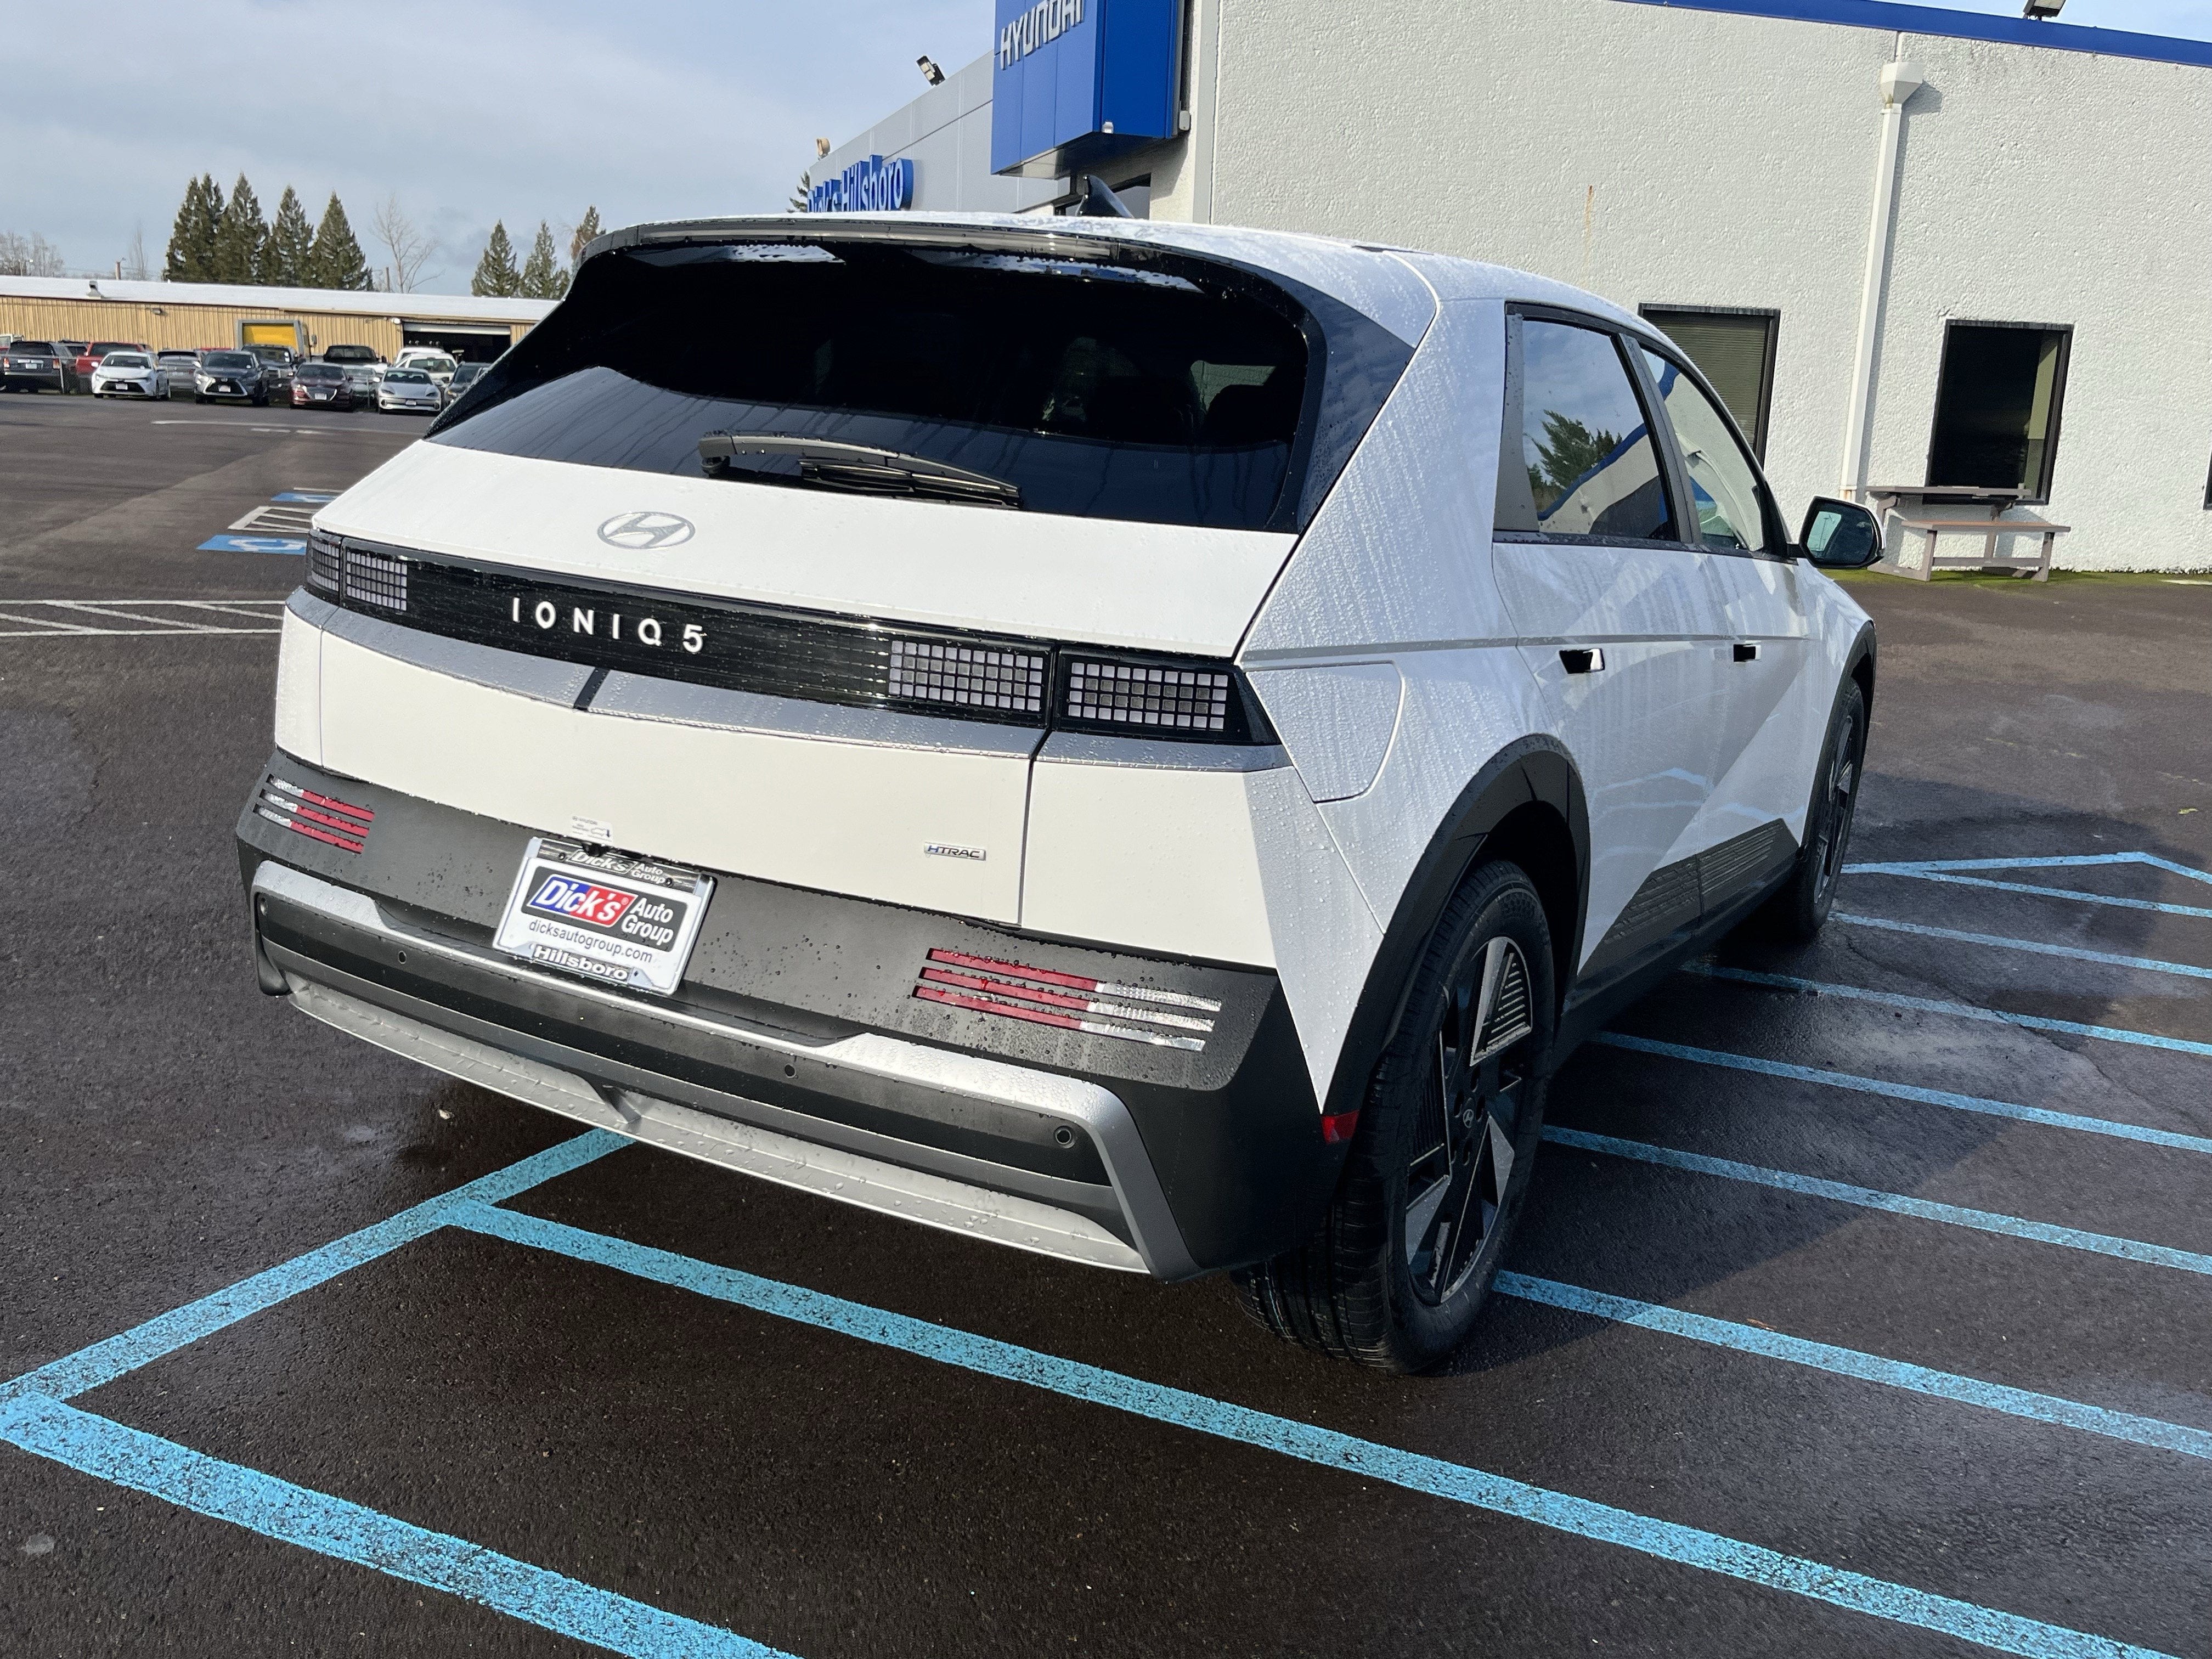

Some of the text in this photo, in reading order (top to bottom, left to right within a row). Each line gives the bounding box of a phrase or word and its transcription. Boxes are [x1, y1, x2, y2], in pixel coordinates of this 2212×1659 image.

[1000, 0, 1084, 70] HYUNDAI
[842, 154, 912, 212] Hillsboro
[512, 597, 703, 653] IONIQ 5
[572, 851, 628, 872] Dick's
[927, 845, 980, 858] HTRAC
[631, 870, 667, 884] Group
[637, 863, 664, 876] Auto
[535, 880, 622, 921] Dick's
[630, 897, 674, 923] Auto
[528, 919, 653, 963] dicksautogroup.com
[620, 915, 674, 946] Group
[533, 945, 628, 980] Hillsboro
